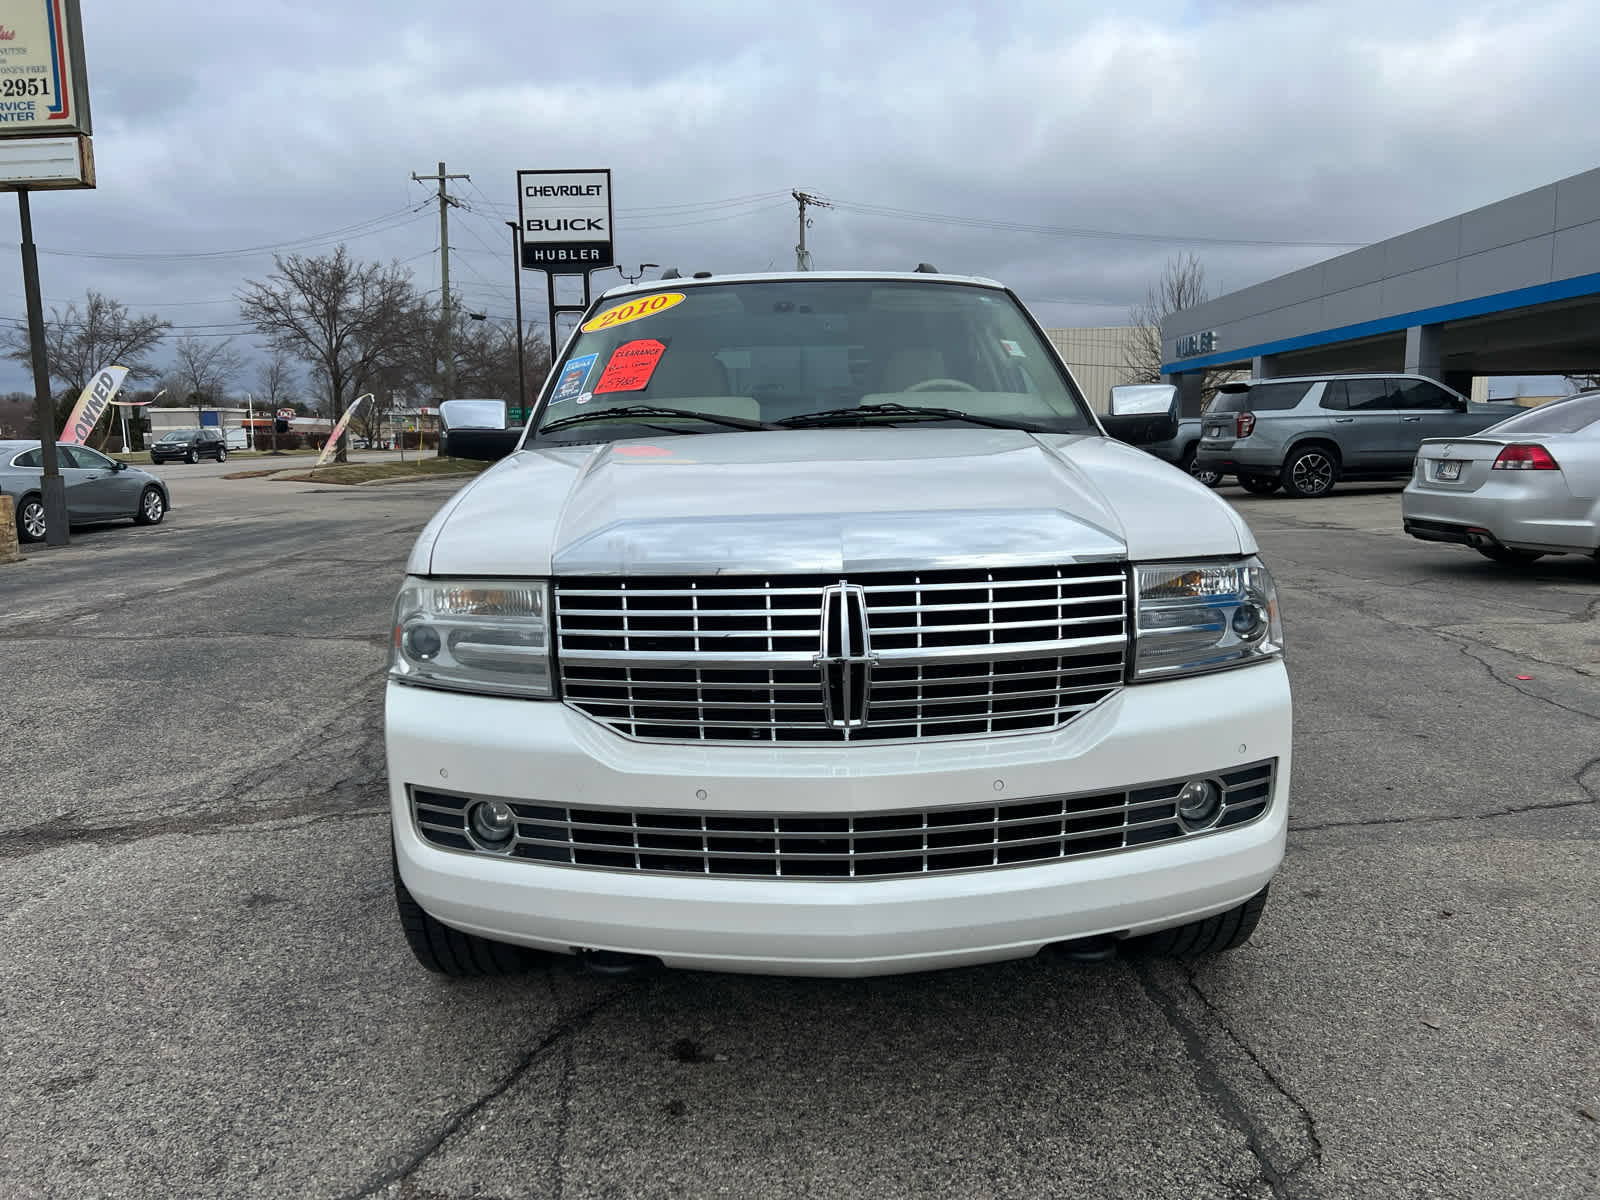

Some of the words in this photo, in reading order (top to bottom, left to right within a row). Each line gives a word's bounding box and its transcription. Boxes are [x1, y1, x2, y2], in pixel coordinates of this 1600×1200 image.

[525, 185, 602, 197] CHEVROLET
[526, 218, 604, 231] BUICK
[535, 249, 600, 260] HUBLER
[600, 296, 667, 327] 2010
